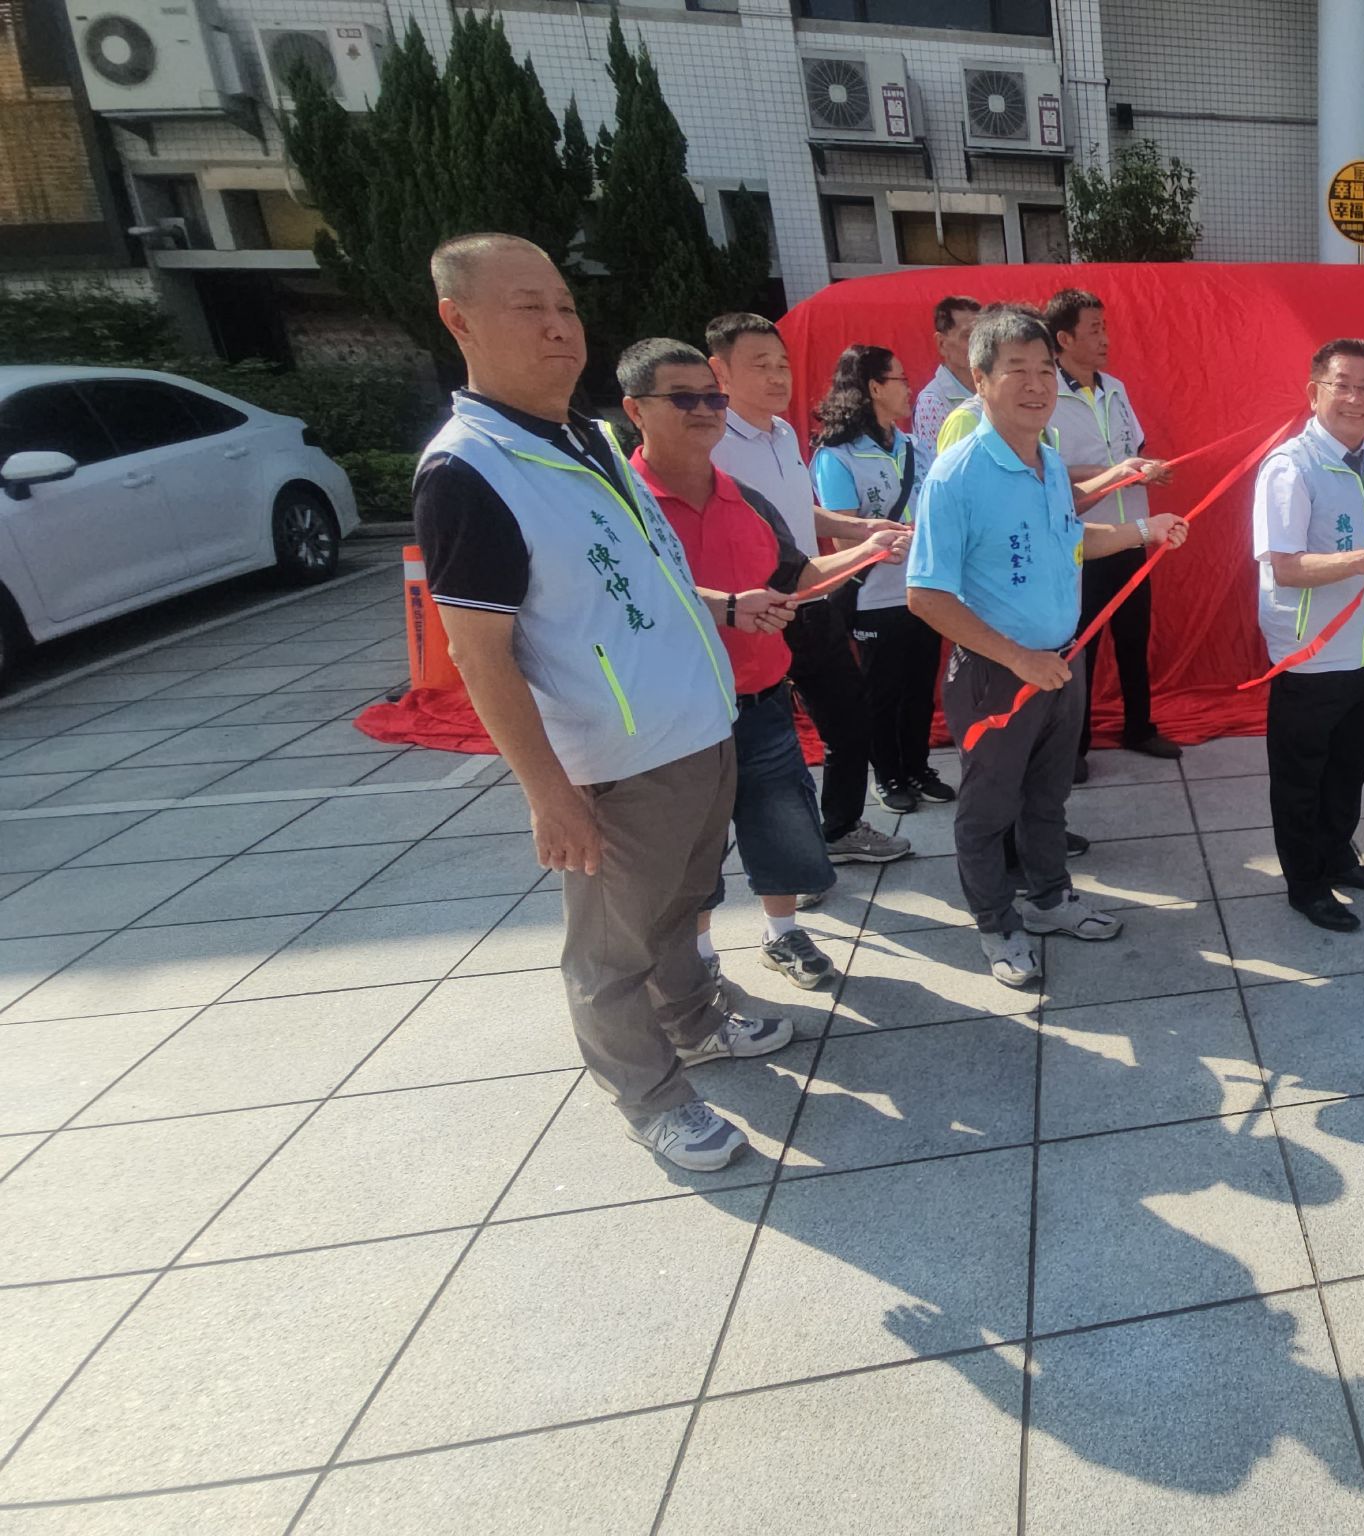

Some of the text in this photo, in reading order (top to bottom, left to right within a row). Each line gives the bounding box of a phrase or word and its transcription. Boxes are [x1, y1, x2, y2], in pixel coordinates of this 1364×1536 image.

[883, 89, 904, 98] SAMPO
[1039, 100, 1059, 109] SAMPO
[590, 510, 622, 545] 委員
